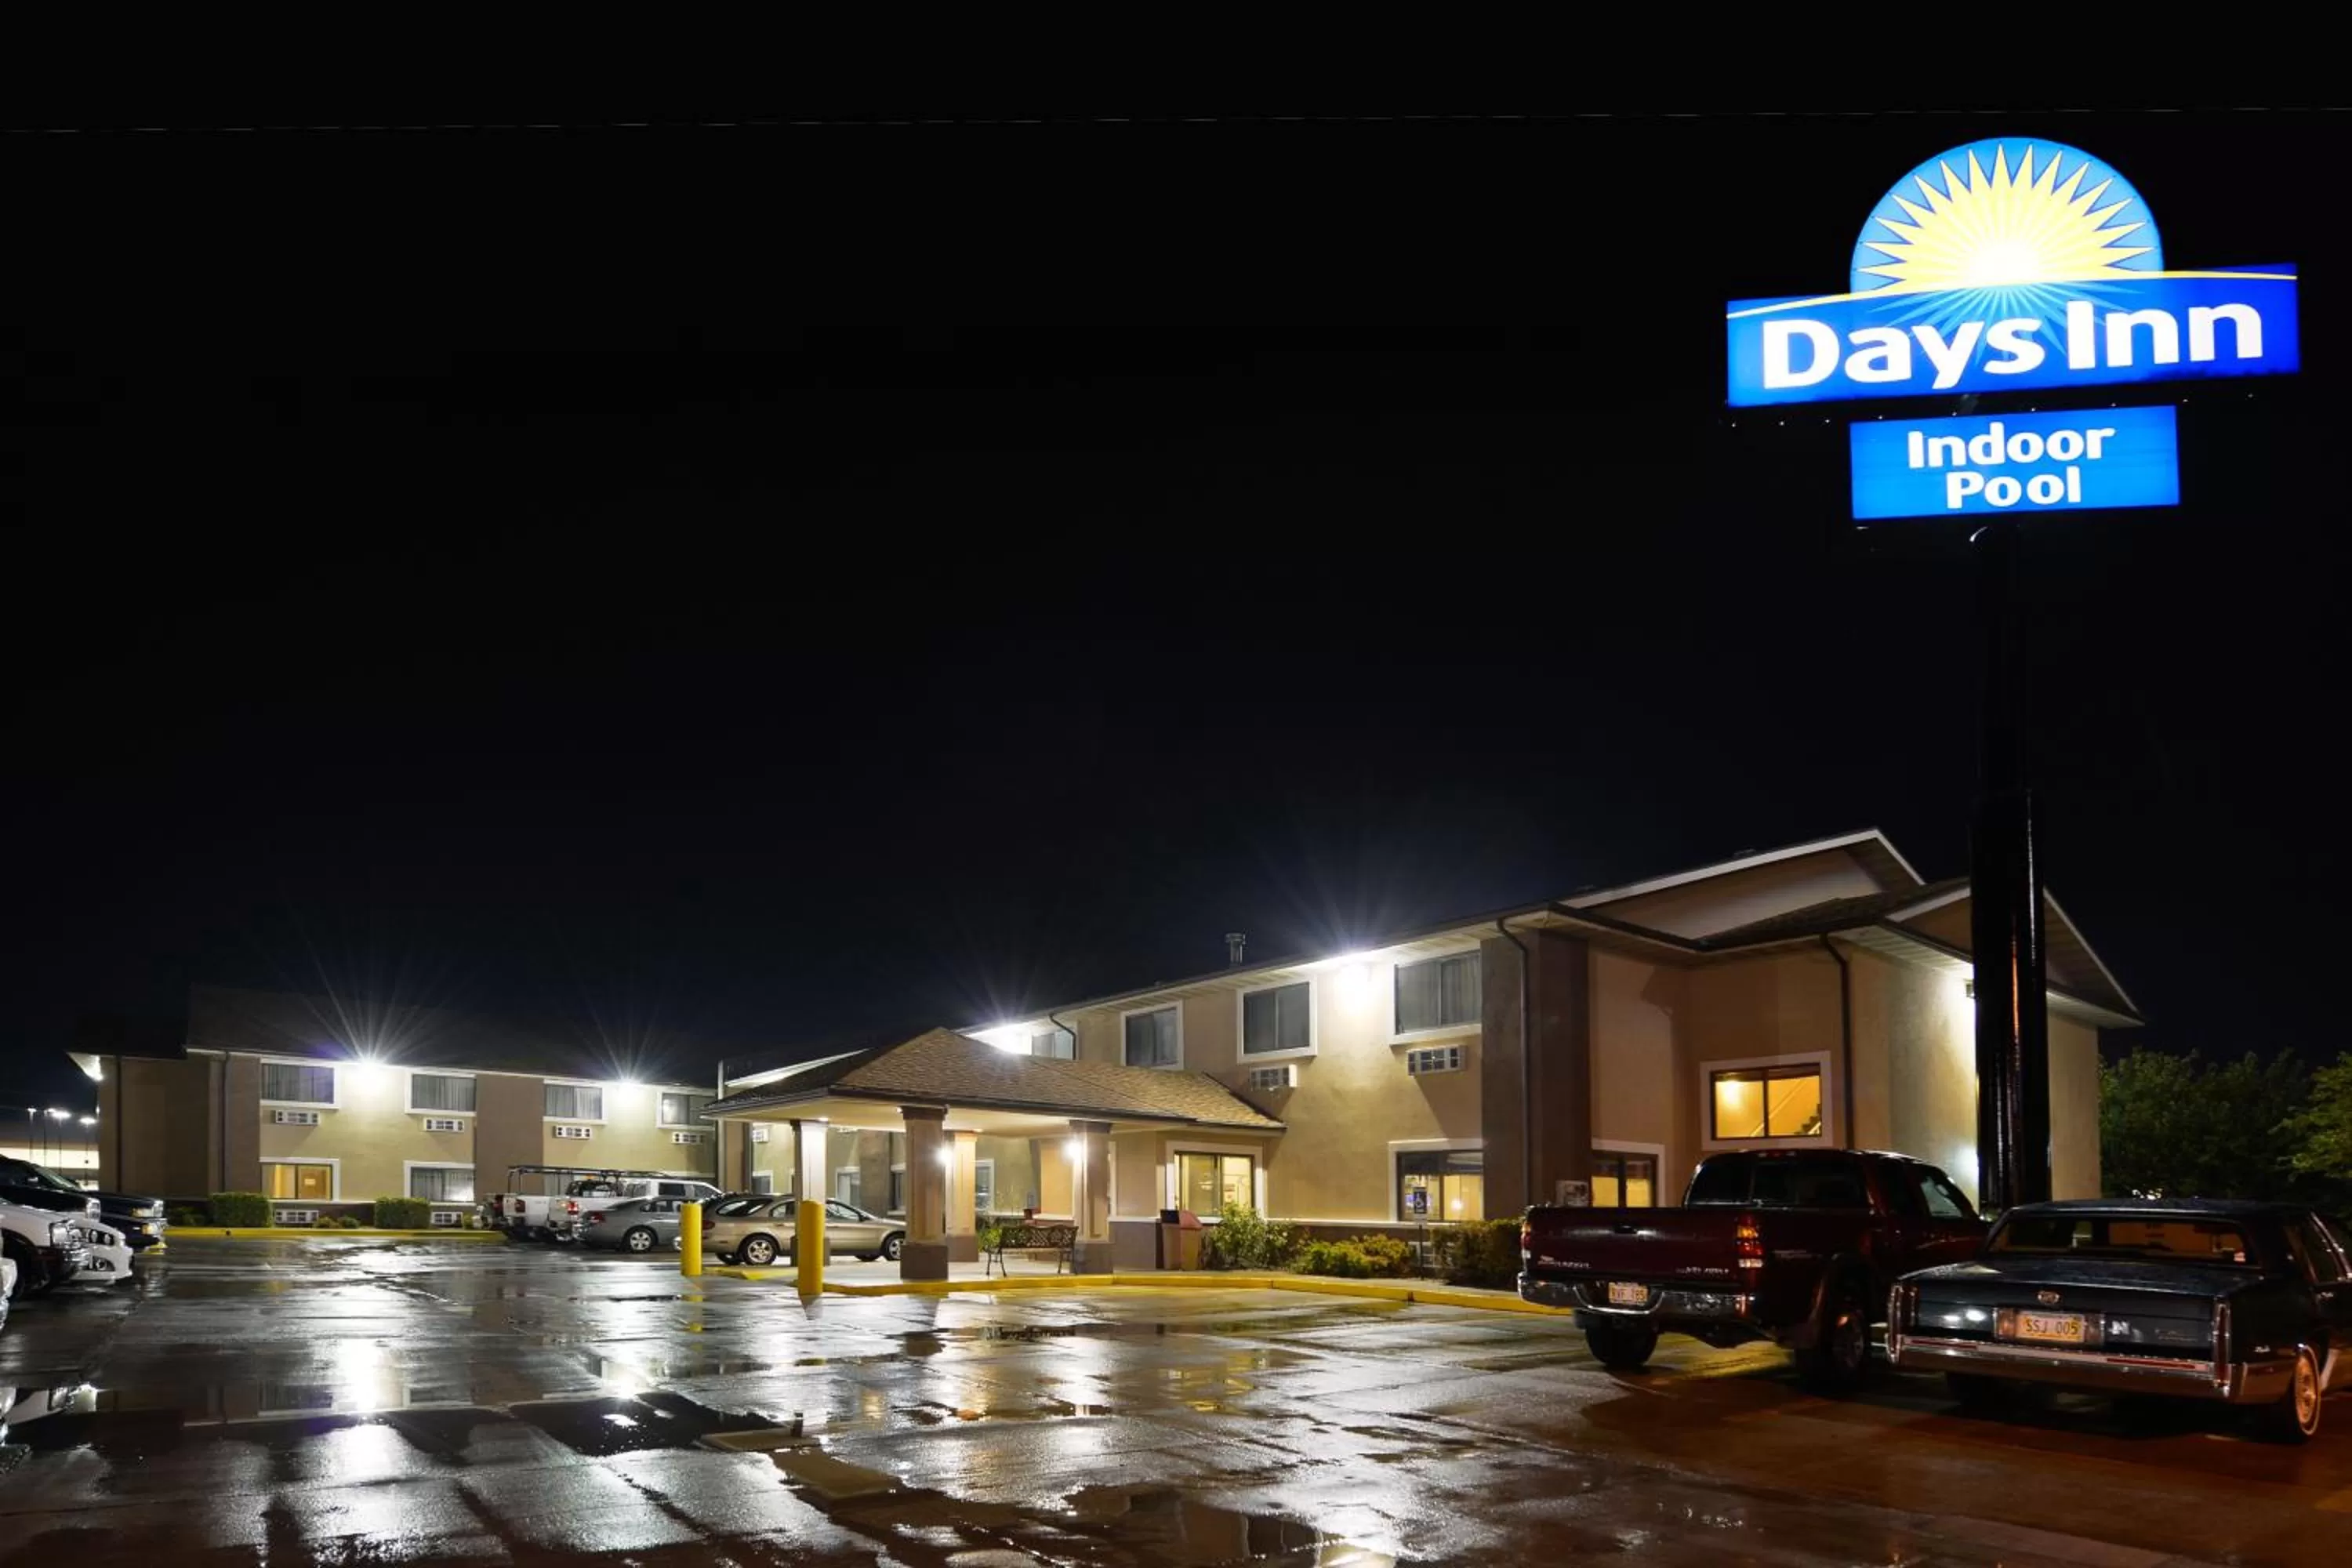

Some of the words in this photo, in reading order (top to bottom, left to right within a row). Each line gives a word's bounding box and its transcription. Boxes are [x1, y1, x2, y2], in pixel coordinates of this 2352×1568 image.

[1763, 318, 2045, 390] Days
[2067, 300, 2263, 369] Inn
[1907, 422, 2115, 468] Indoor
[1947, 466, 2082, 509] Pool
[2055, 1321, 2079, 1335] 005
